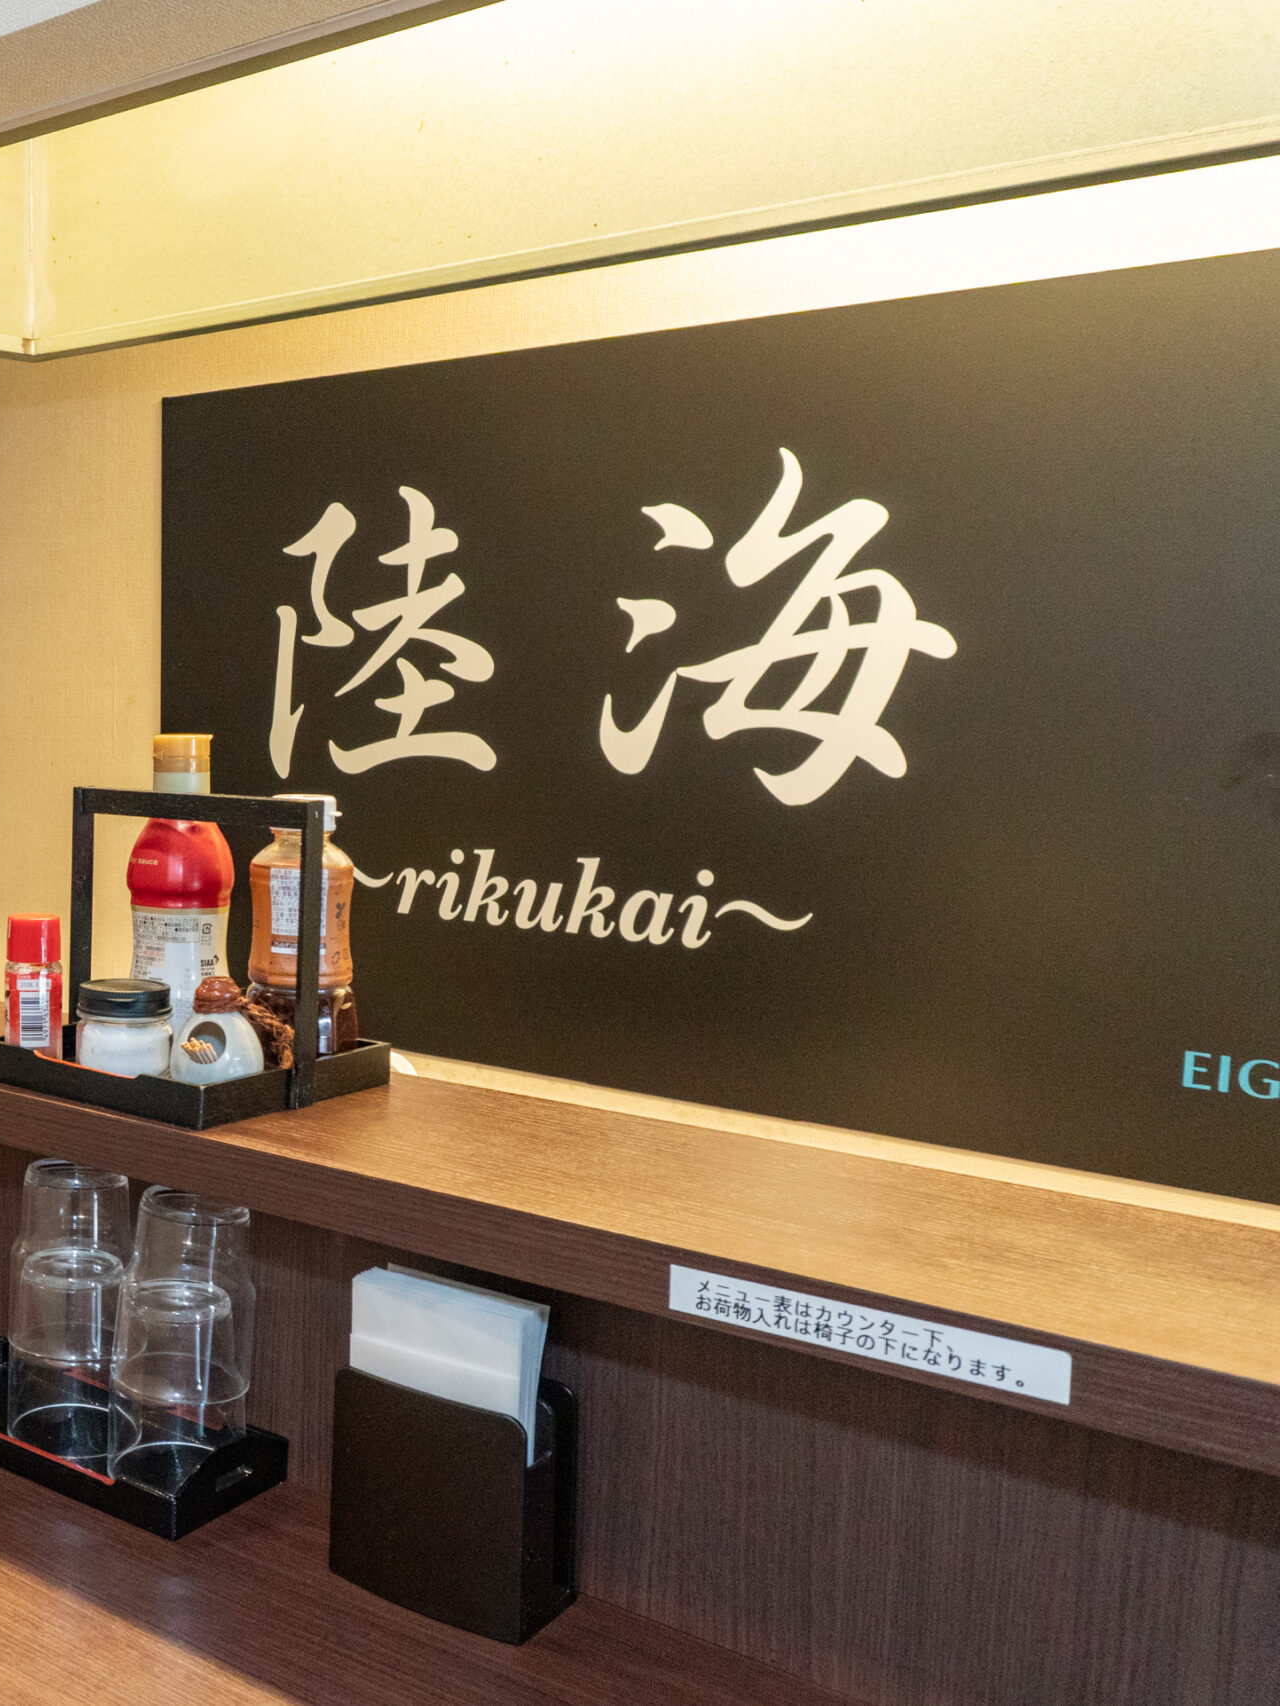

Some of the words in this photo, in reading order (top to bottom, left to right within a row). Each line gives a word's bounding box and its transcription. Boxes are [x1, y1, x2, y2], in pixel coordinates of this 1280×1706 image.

[269, 447, 958, 806] 陸海
[137, 857, 159, 867] sauce
[1182, 1050, 1280, 1099] EIG
[695, 1295, 1026, 1389] お荷物入れは椅子の下になります。
[696, 1280, 956, 1353] メニュー表はカウンター下、
